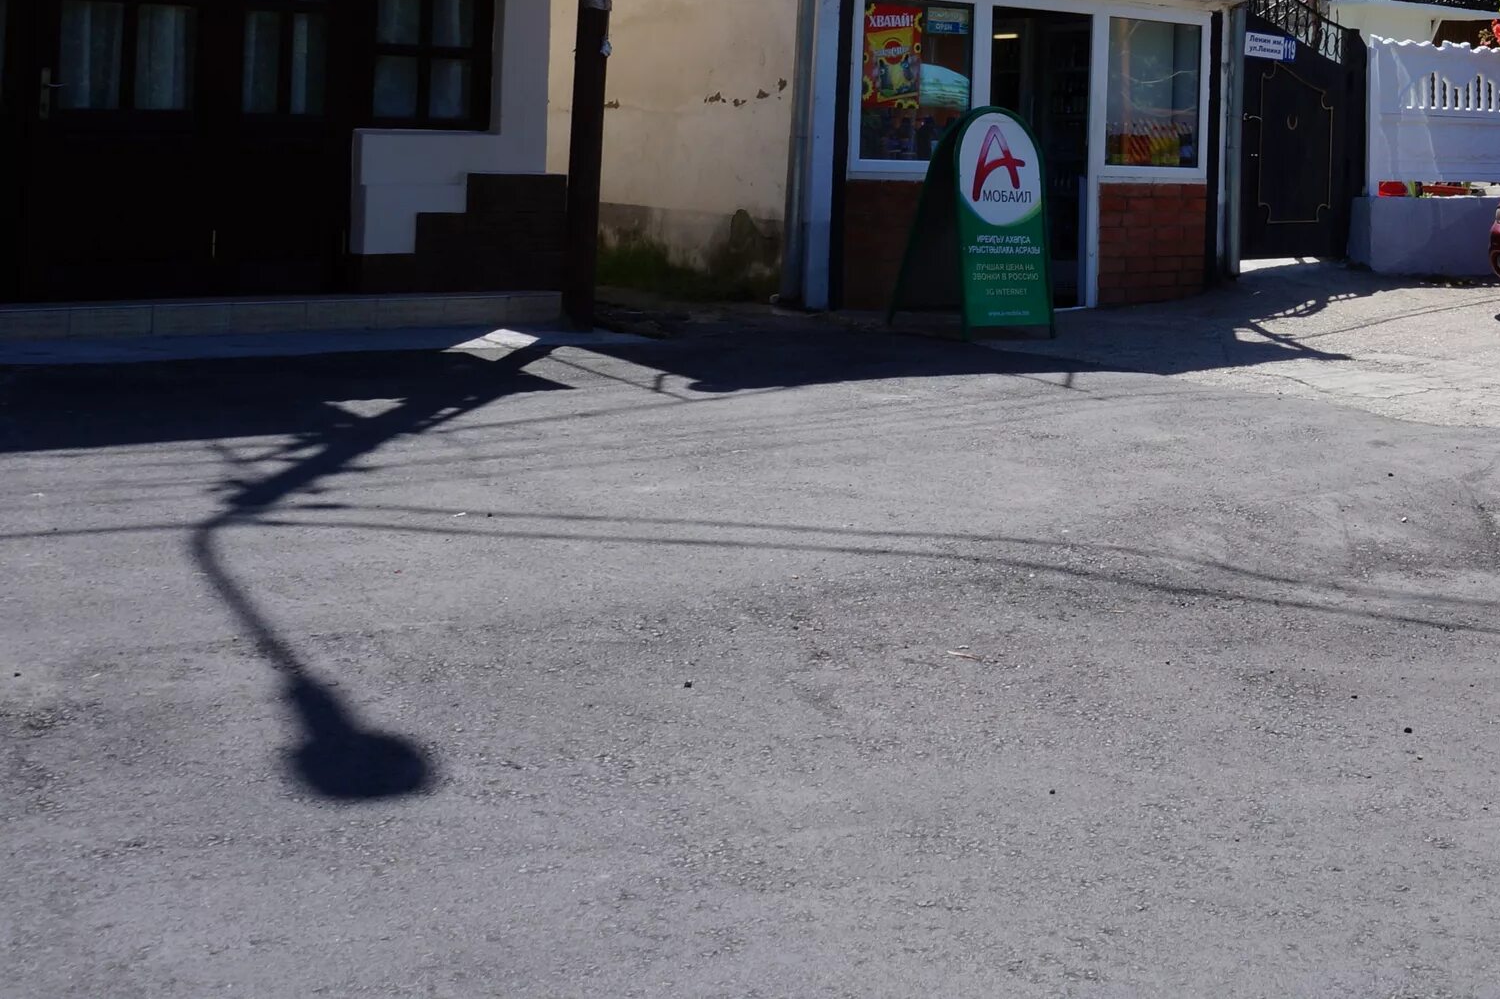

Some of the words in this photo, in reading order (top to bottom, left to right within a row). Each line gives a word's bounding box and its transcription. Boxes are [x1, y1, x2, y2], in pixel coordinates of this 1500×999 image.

[869, 12, 914, 28] ХВАТАЙ!
[935, 22, 953, 32] OPEN
[1249, 34, 1271, 44] Ленин
[1284, 39, 1296, 60] 119
[976, 263, 1005, 271] ЛУЧШАЯ
[1005, 263, 1024, 271] ЦЕНА
[1025, 263, 1035, 271] НА
[972, 272, 1001, 281] ЗВОНКИ
[1001, 273, 1007, 281] В
[1008, 273, 1039, 281] РОССИЮ
[995, 288, 1028, 296] INTERNET
